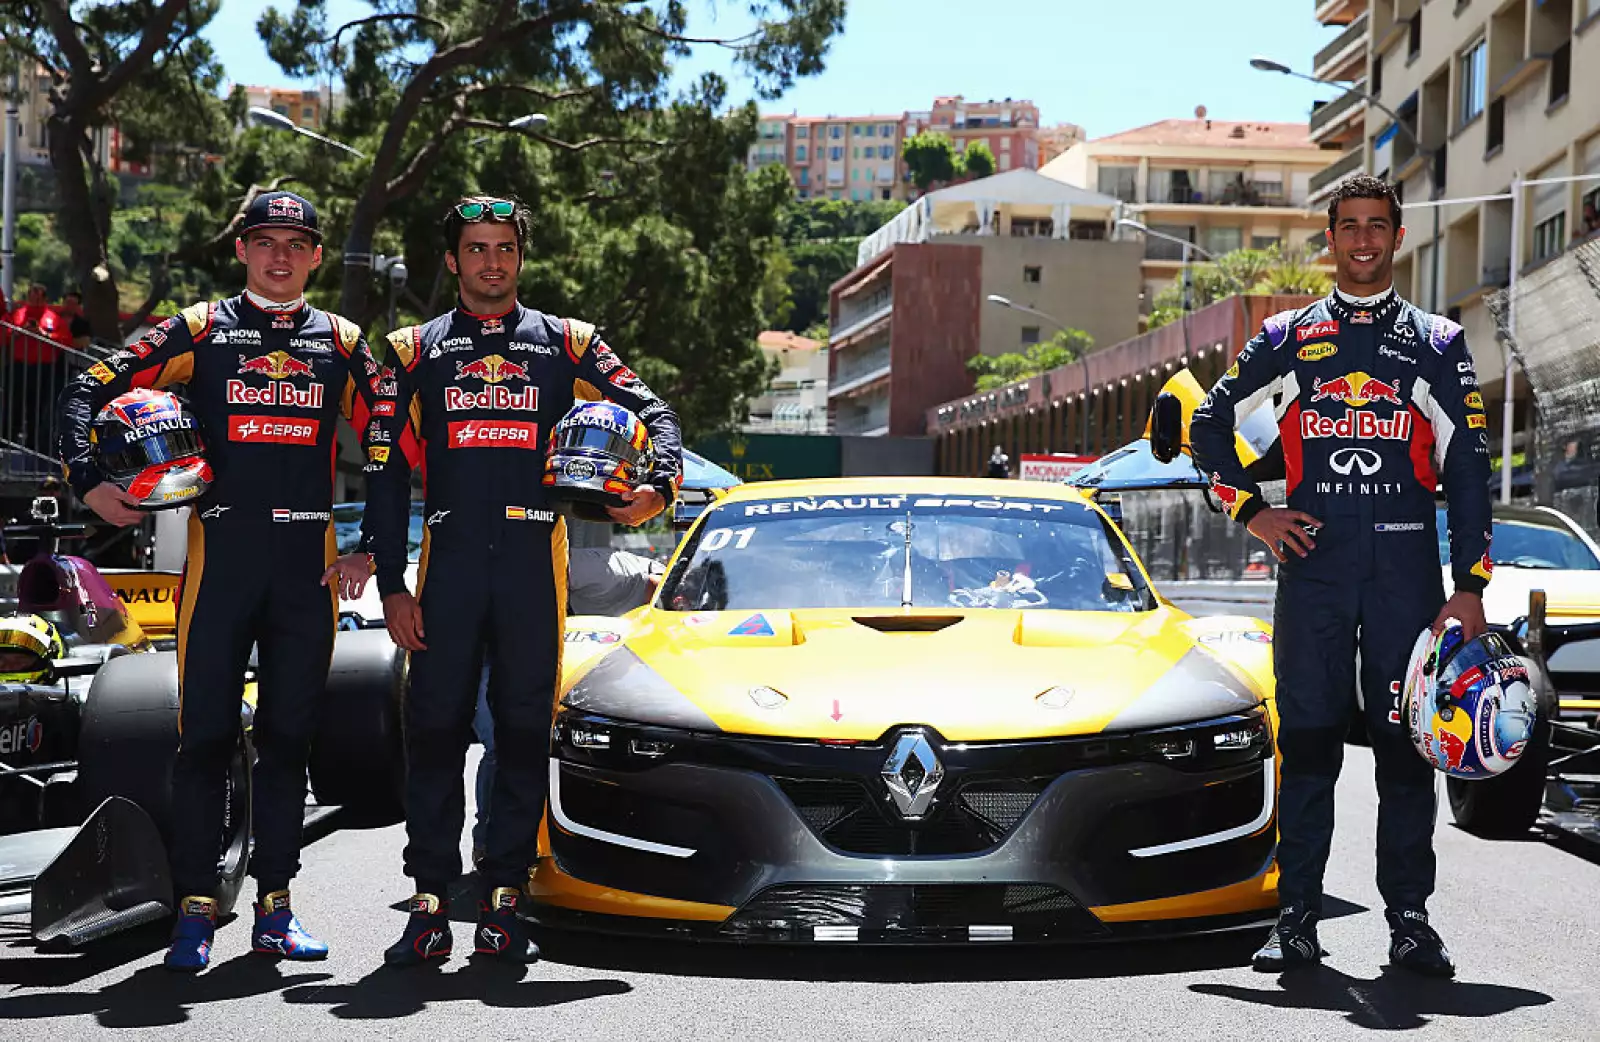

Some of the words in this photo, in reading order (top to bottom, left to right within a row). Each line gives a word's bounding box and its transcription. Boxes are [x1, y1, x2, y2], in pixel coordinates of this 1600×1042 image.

[228, 329, 261, 339] NOVA
[1299, 324, 1337, 339] TOTAL
[441, 336, 473, 348] NOVA
[508, 341, 552, 354] SAPINDA
[227, 379, 277, 405] Red
[279, 381, 324, 409] Bull
[445, 384, 493, 412] Red
[494, 386, 539, 412] Bull
[124, 417, 192, 444] RENAULT
[262, 423, 313, 438] CEPSA
[562, 413, 627, 436] RENAULT
[1301, 408, 1353, 440] Red
[1355, 410, 1412, 441] Bull
[477, 427, 529, 441] CEPSA
[1316, 482, 1402, 495] INFINITI
[526, 509, 554, 522] SAINZ
[744, 497, 907, 517] RENAULT
[914, 499, 1064, 514] SPORT
[700, 527, 757, 551] 01
[0, 723, 26, 754] elf
